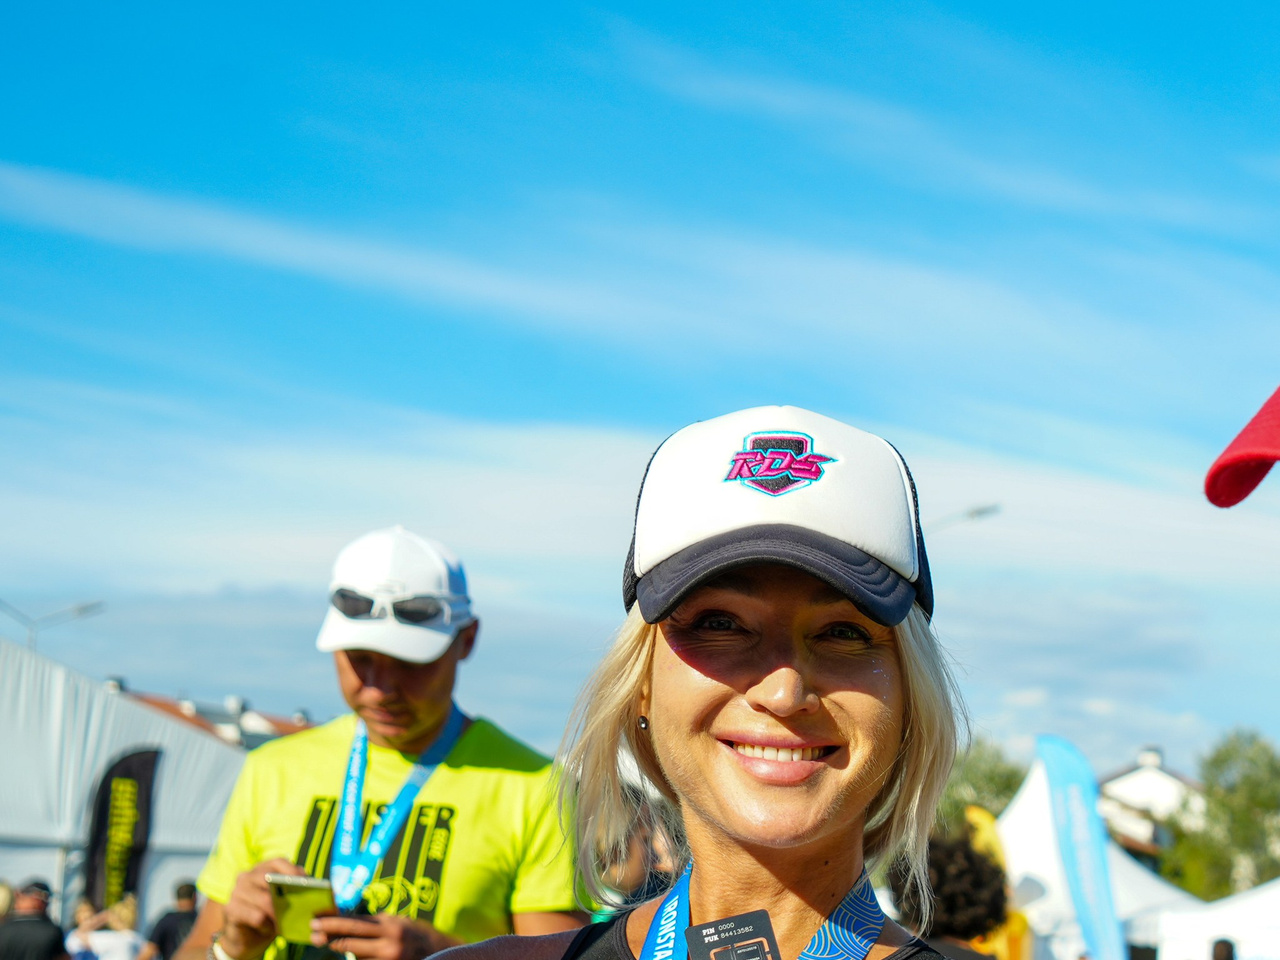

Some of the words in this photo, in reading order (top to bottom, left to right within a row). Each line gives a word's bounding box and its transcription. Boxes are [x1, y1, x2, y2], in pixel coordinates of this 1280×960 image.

[724, 450, 837, 482] RDS
[702, 927, 714, 935] PIN
[718, 922, 734, 930] 0000
[704, 935, 719, 943] PUK
